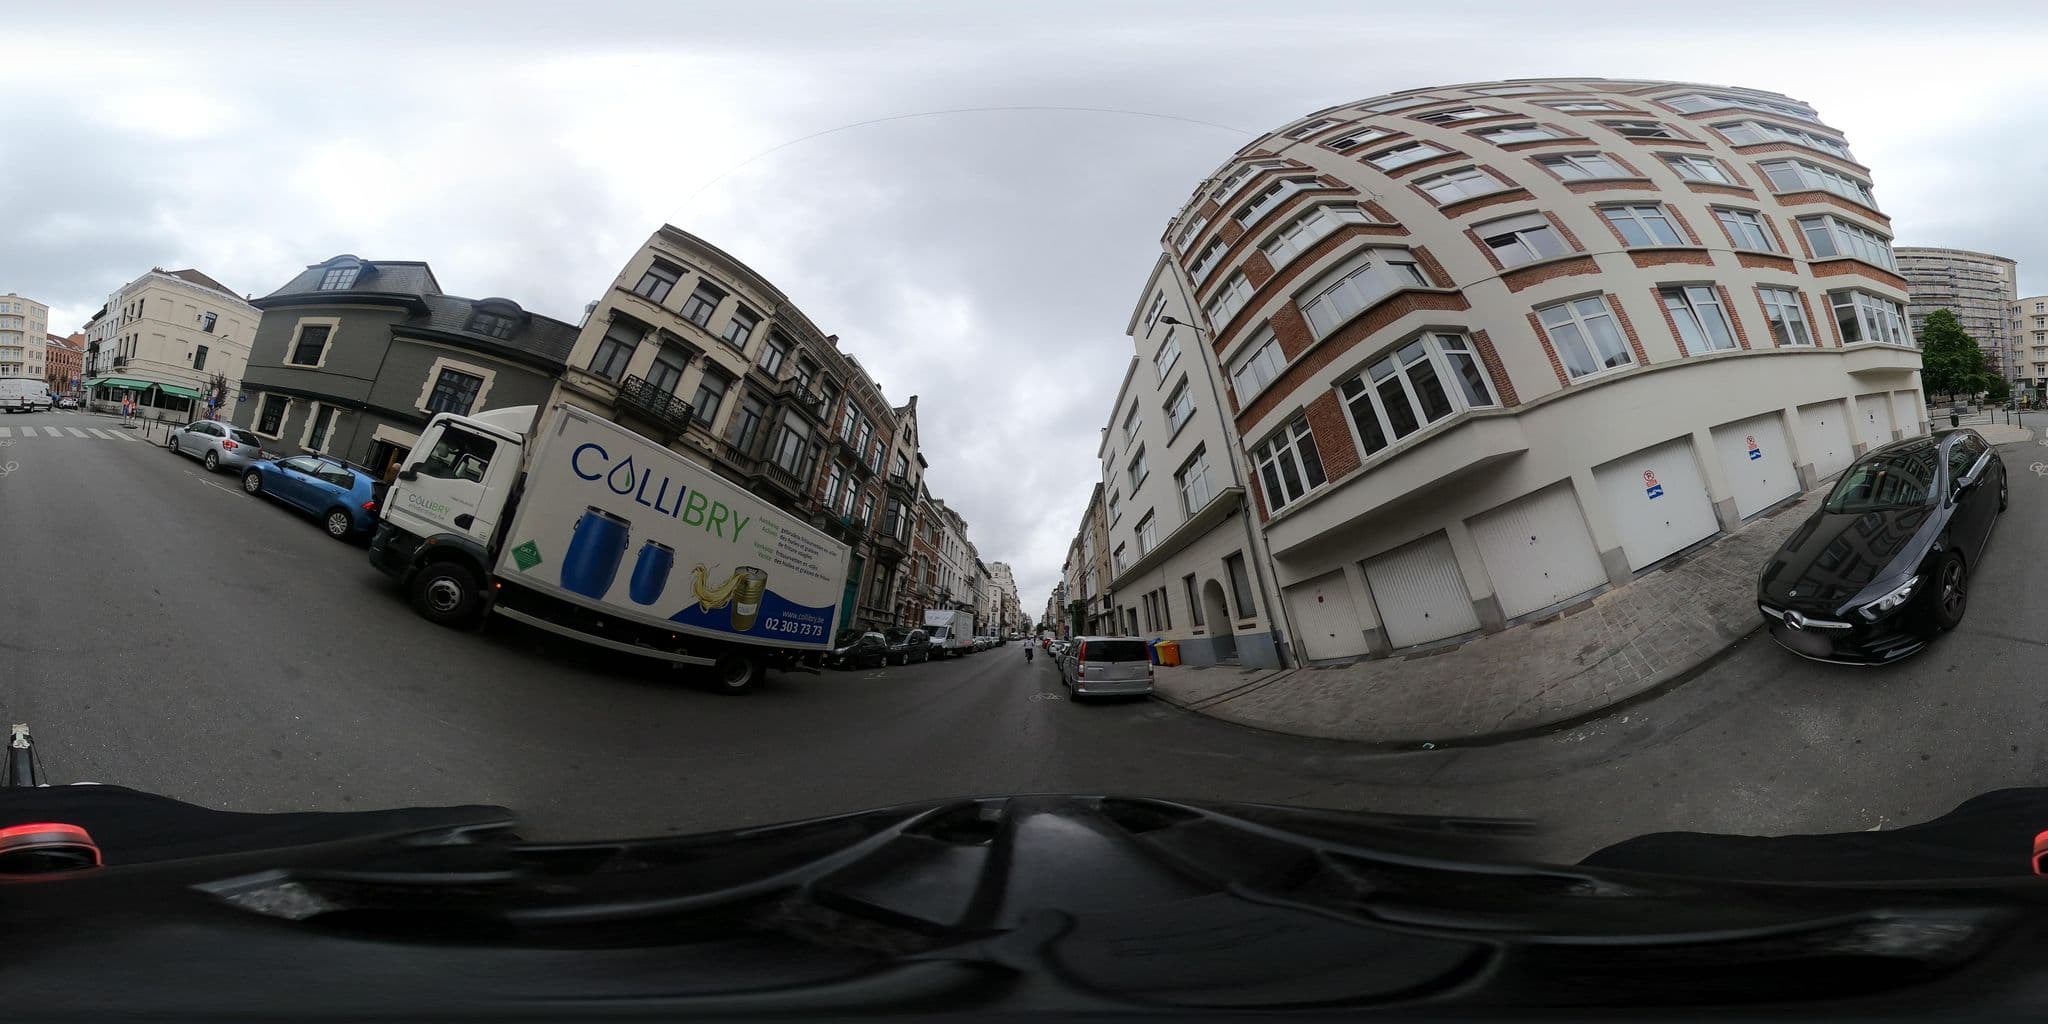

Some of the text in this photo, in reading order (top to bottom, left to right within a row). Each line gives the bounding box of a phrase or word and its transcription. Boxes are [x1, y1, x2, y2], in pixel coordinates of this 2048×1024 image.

[571, 442, 751, 544] COLLIBRY
[765, 617, 823, 637] 02 303 73 73
